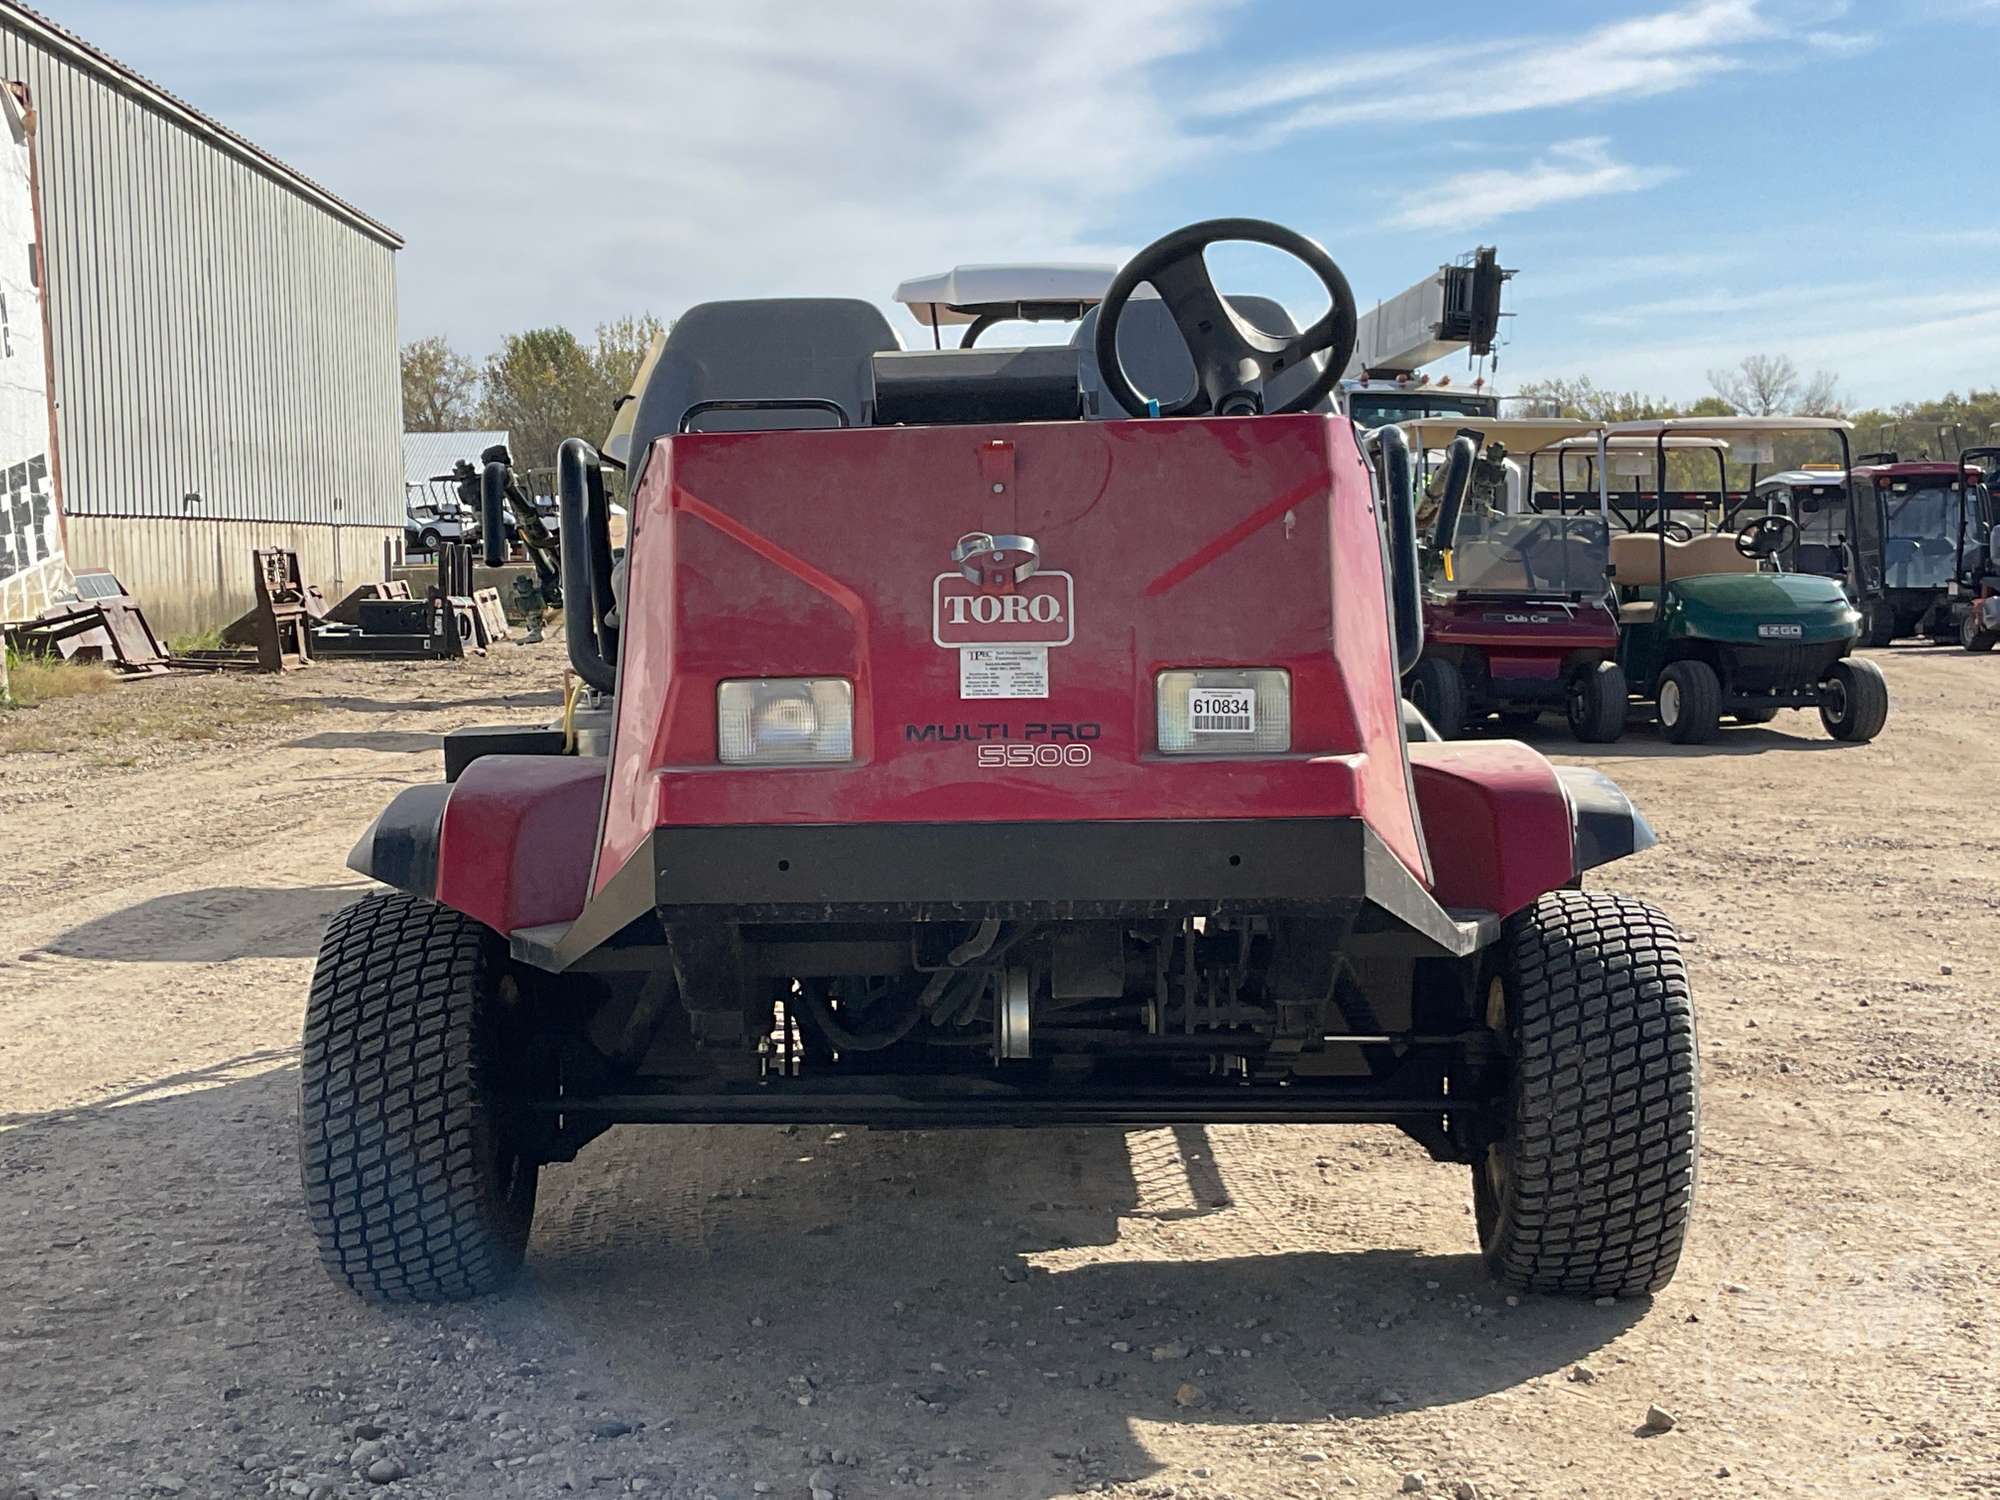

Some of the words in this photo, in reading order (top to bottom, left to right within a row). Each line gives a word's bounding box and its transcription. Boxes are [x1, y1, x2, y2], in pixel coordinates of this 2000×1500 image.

[1504, 614, 1528, 623] Club
[1530, 614, 1549, 623] Car
[1193, 699, 1249, 714] 610834
[906, 723, 1008, 741] MULTI
[1025, 723, 1101, 740] PRO
[978, 744, 1092, 767] 5500
